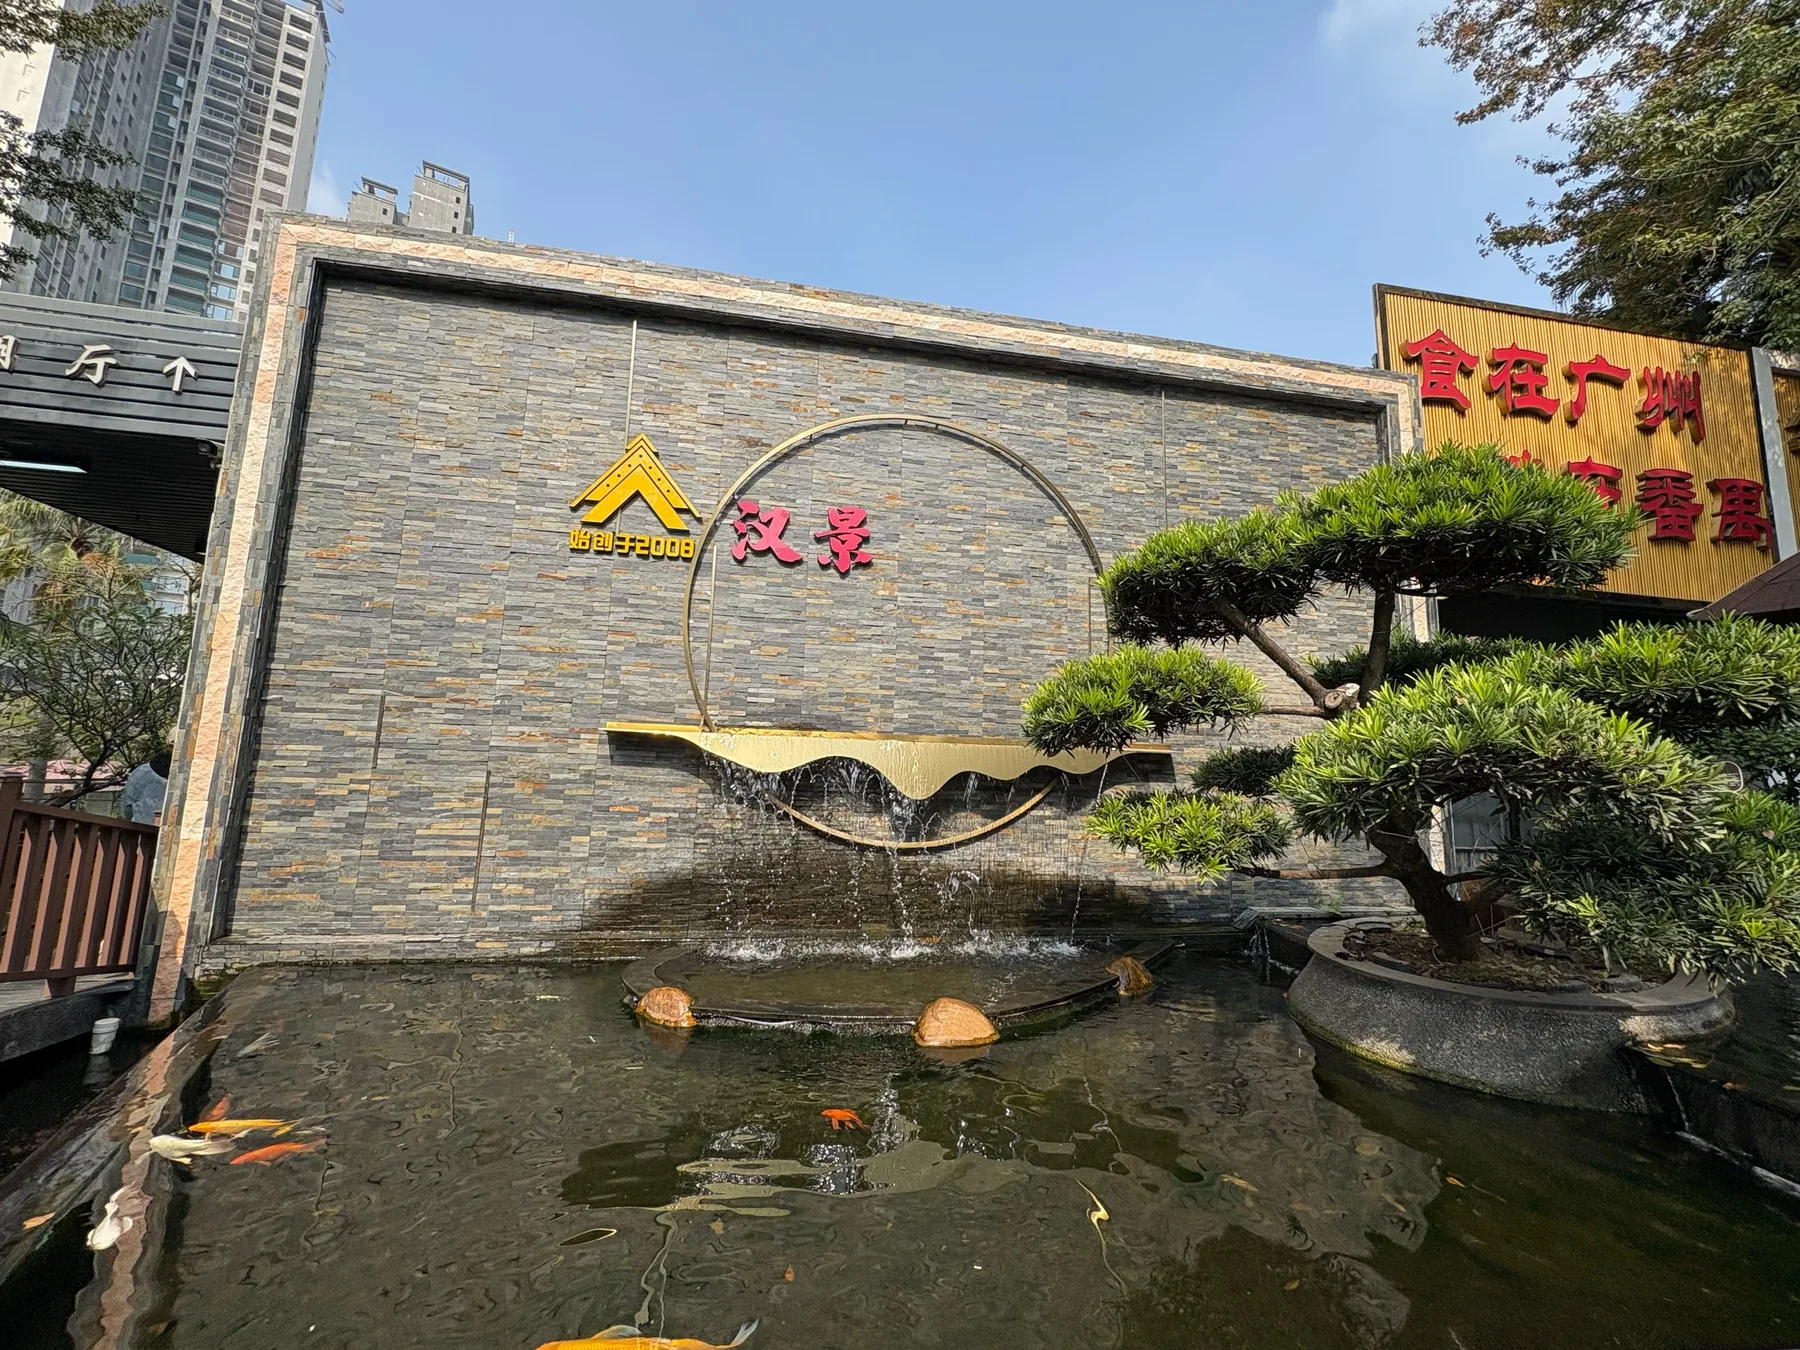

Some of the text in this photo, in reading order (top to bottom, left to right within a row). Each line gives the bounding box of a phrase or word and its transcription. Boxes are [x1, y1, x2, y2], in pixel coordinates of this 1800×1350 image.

[1402, 328, 1706, 443] 食在广州
[568, 529, 695, 559] 始创于2008
[731, 499, 874, 573] 汉景
[1502, 449, 1773, 551] 番禺
